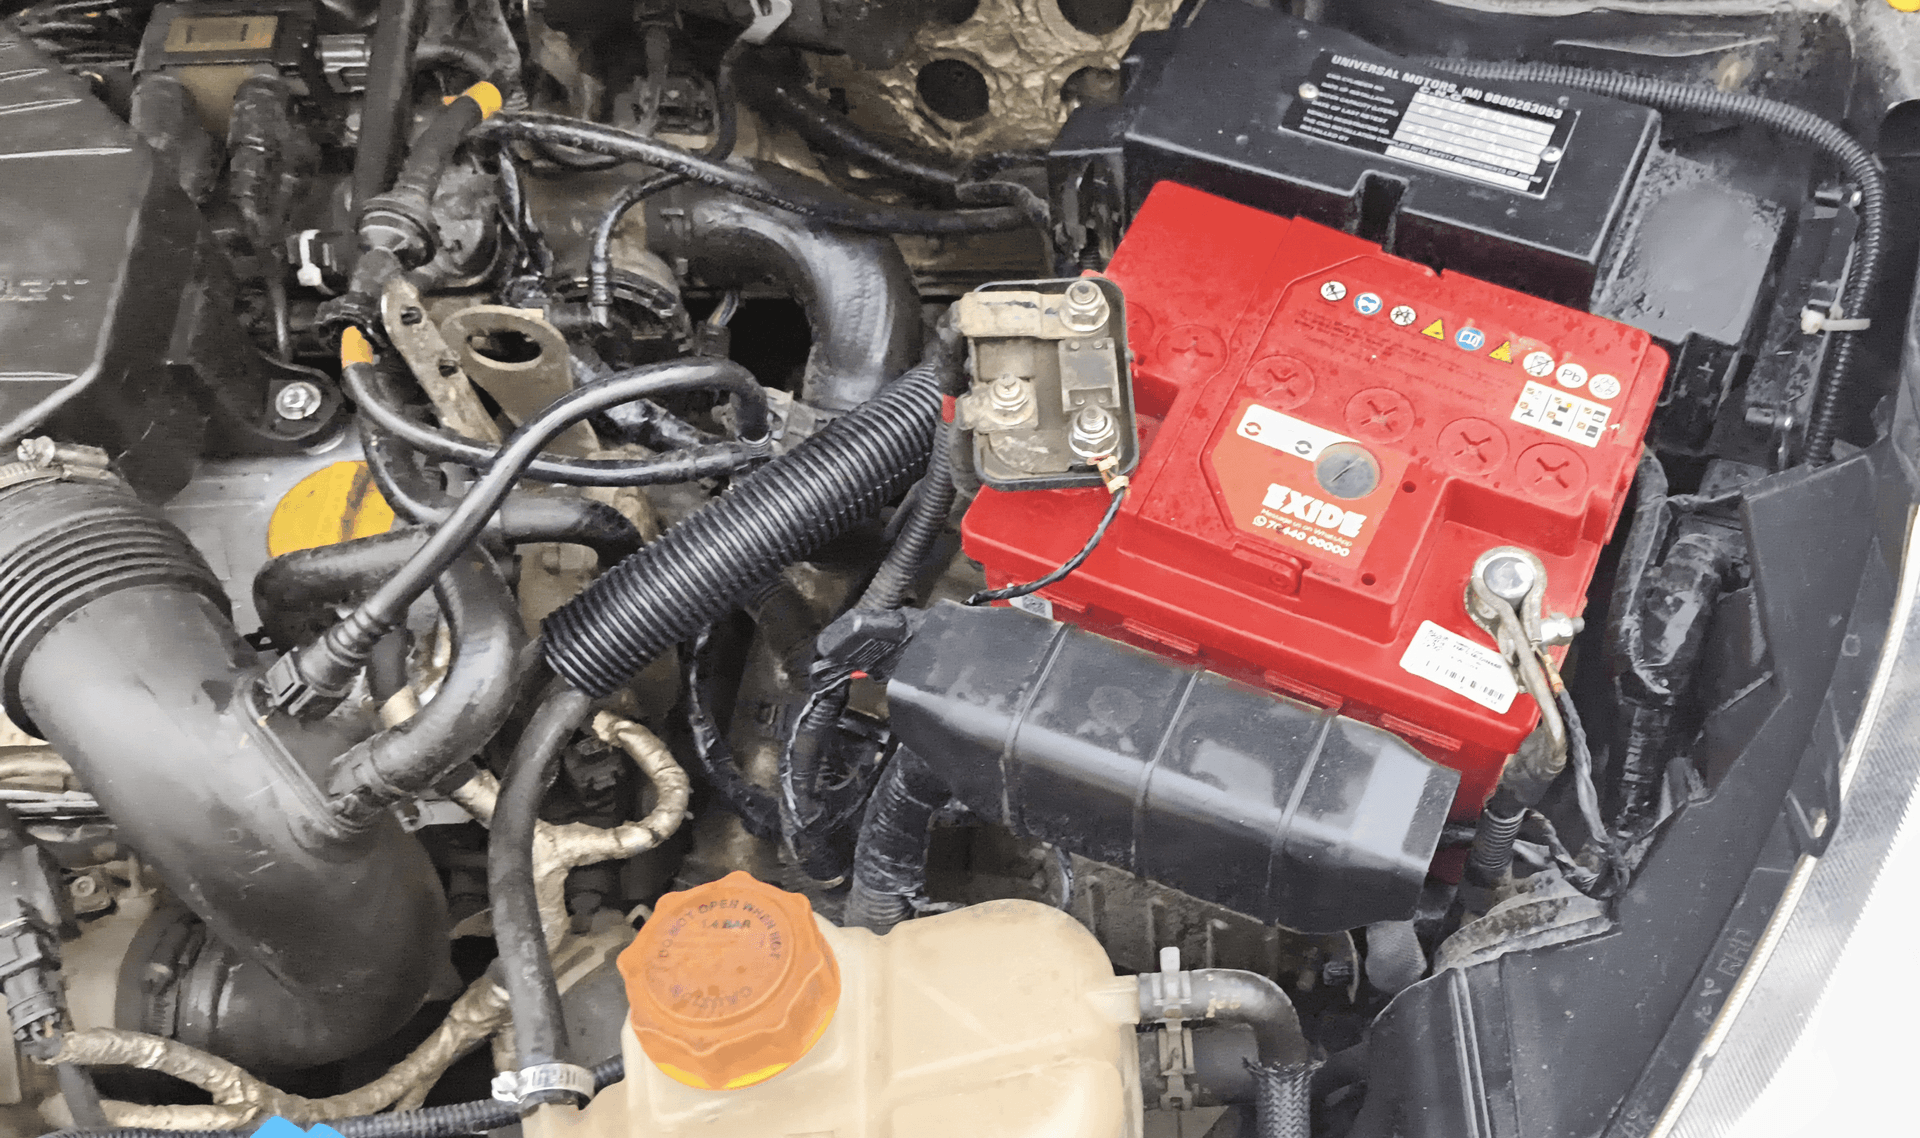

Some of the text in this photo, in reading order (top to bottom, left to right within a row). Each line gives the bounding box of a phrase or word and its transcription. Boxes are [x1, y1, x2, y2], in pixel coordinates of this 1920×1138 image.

[1331, 54, 1400, 80] UNIVERSAL
[1461, 87, 1484, 101] (M)
[1483, 91, 1564, 119] 9880263053
[1561, 368, 1582, 383] Pb
[1262, 483, 1367, 538] EXIDE
[1261, 508, 1353, 547] Message us on WhatsApp
[1306, 535, 1351, 557] 00000
[698, 899, 740, 914] OPEN
[742, 902, 777, 930] WHEN
[722, 919, 751, 930] BAR
